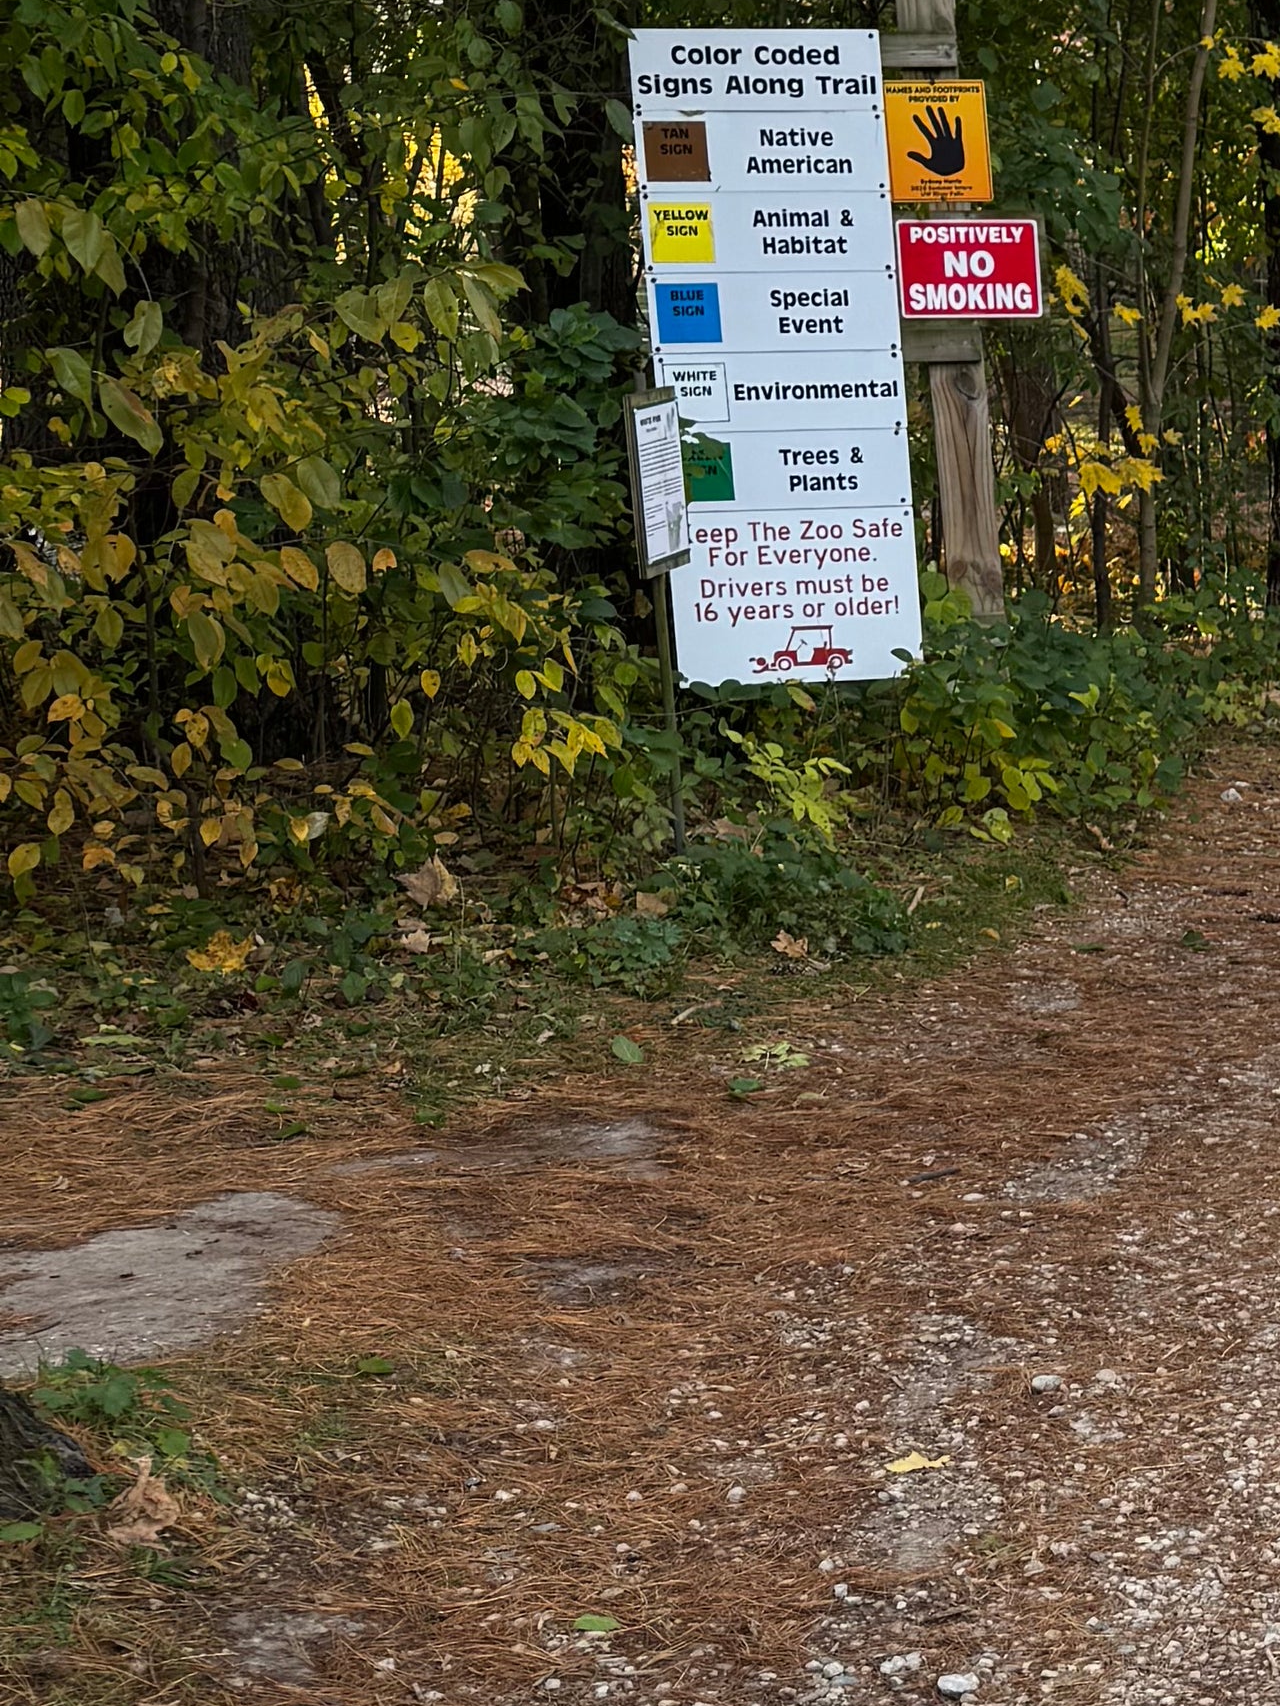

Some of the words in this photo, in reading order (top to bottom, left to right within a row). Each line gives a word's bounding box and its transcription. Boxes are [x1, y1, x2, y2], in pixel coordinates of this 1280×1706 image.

[671, 45, 742, 65] Color
[754, 45, 840, 65] Coded
[637, 74, 713, 98] Signs
[725, 75, 804, 98] Along
[815, 75, 877, 95] Trail
[661, 128, 689, 139] TAN
[759, 128, 834, 147] Native
[660, 144, 693, 155] SIGN
[746, 155, 853, 174] American
[653, 209, 708, 221] YELLOW
[752, 209, 829, 228] Animal
[840, 209, 854, 227] &
[666, 225, 699, 237] SIGN
[909, 226, 1024, 244] POSITIVELY
[762, 236, 848, 255] Habitat
[943, 250, 995, 278] NO
[670, 290, 704, 302] BLUE
[769, 288, 849, 310] Special
[909, 282, 1033, 310] SMOKING
[672, 305, 705, 317] SIGN
[778, 315, 844, 334] Event
[672, 370, 717, 382] WHITE
[680, 386, 712, 397] SIGN
[733, 380, 899, 401] Environmental
[778, 448, 840, 466] Trees
[850, 446, 864, 464] &
[789, 473, 859, 492] Plants
[689, 524, 738, 548] eep
[747, 521, 791, 542] The
[800, 520, 843, 541] Zoo
[852, 517, 903, 539] Safe
[708, 546, 748, 567] For
[757, 545, 877, 570] Everyone.
[700, 577, 787, 599] Drivers
[796, 574, 853, 595] must
[862, 574, 889, 593] be
[694, 601, 719, 623] 16
[727, 603, 794, 628] years
[802, 601, 825, 619] or
[834, 595, 899, 617] older!
